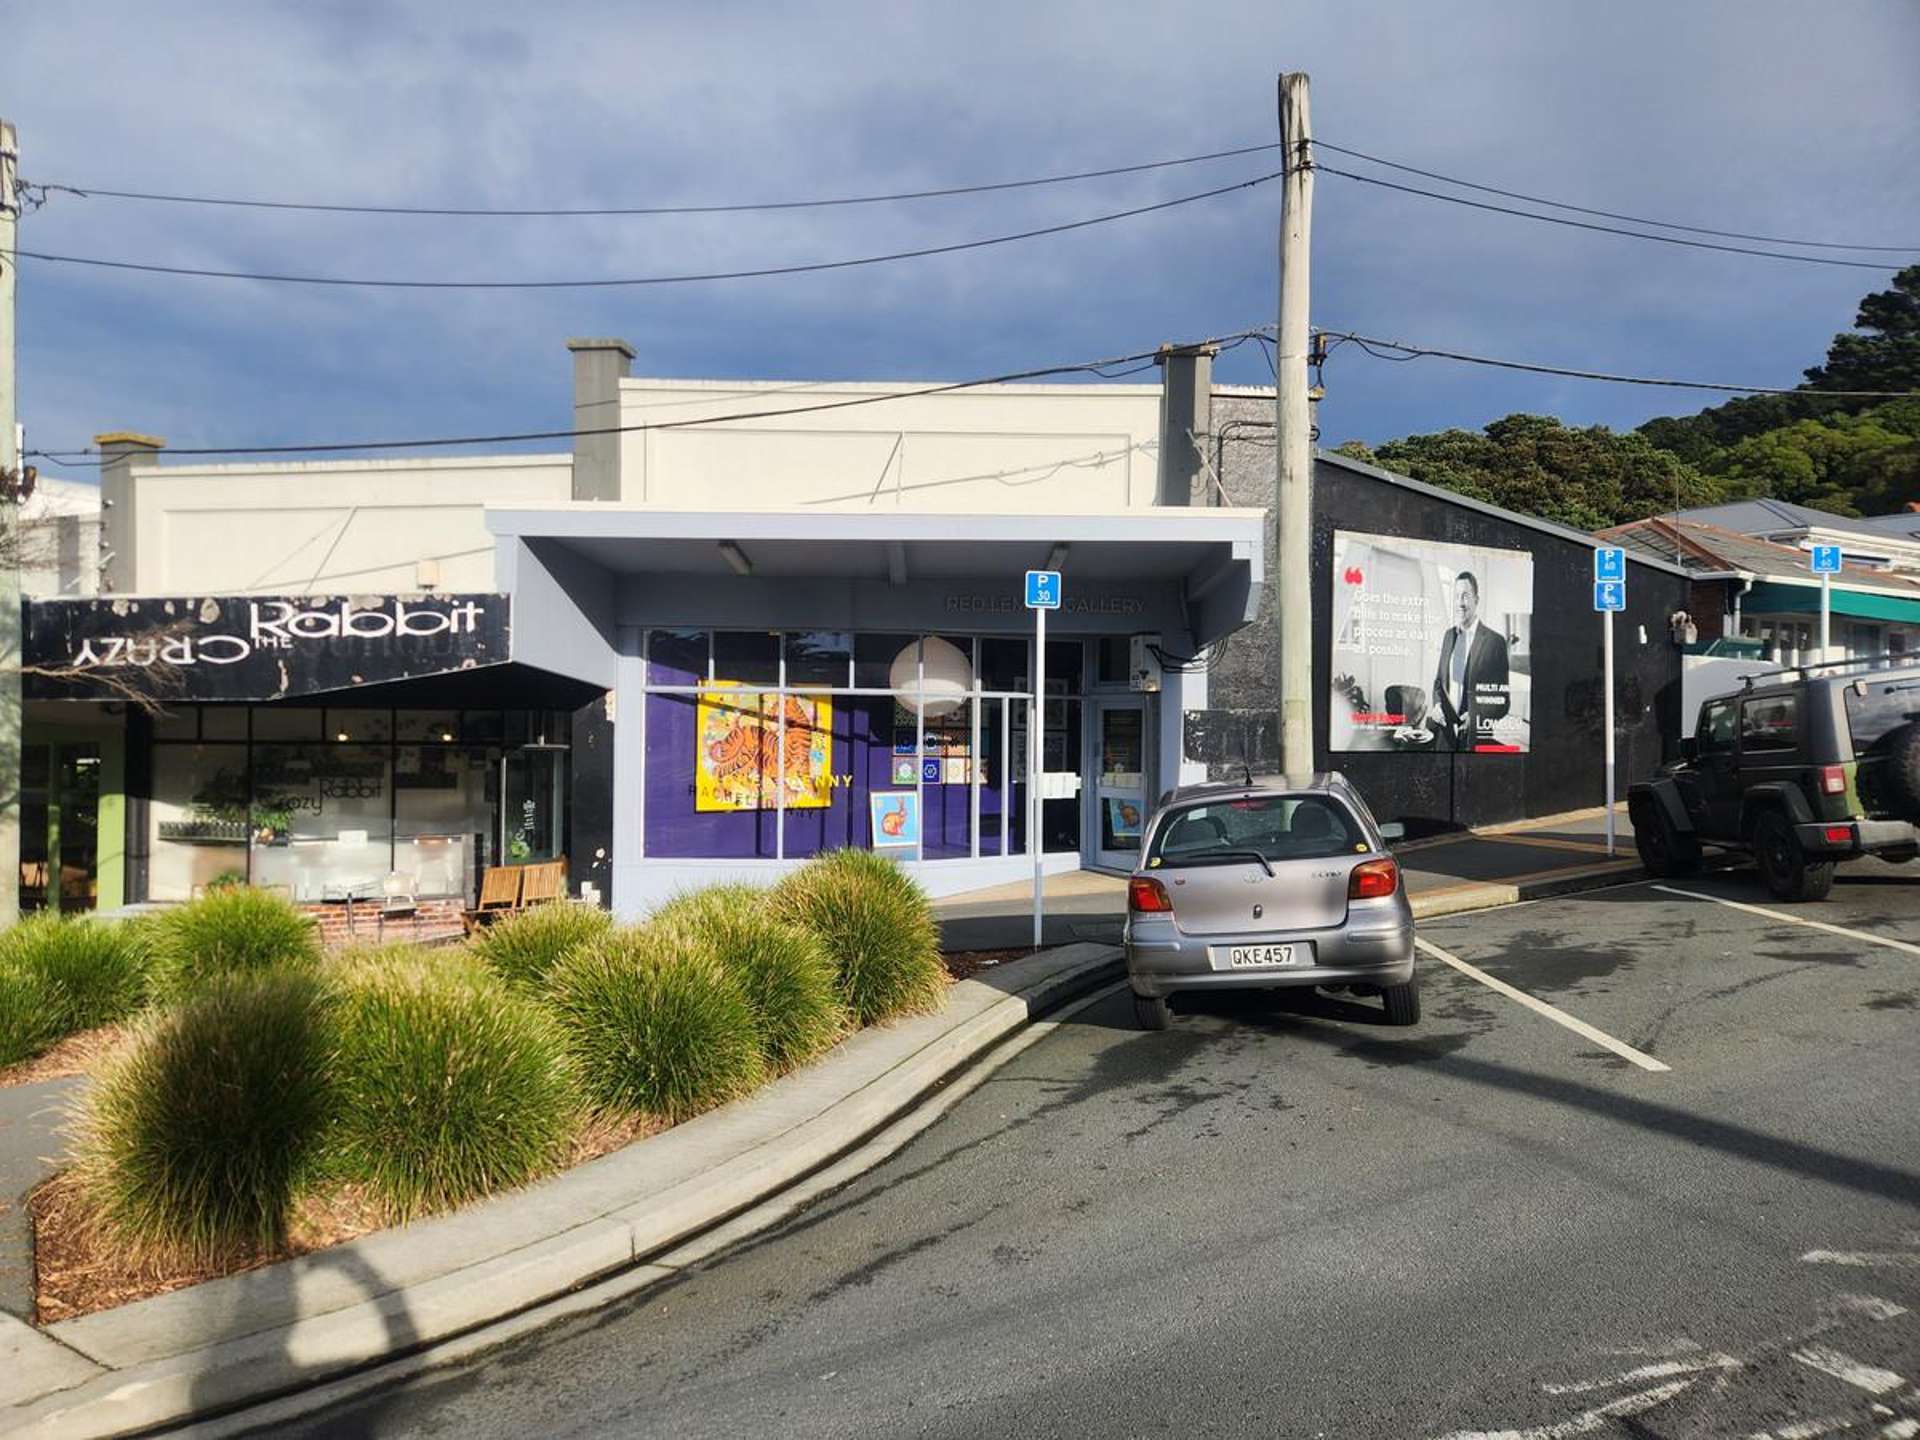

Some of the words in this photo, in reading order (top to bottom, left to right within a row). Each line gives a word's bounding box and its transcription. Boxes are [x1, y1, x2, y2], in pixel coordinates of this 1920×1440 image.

[1605, 551, 1615, 562] P
[1822, 548, 1831, 558] P
[1038, 575, 1049, 588] P
[1037, 590, 1050, 601] 30
[990, 595, 1026, 613] LEM
[250, 600, 485, 638] Rabbit
[73, 634, 250, 667] CRAZY
[253, 635, 293, 649] THE
[1232, 947, 1293, 965] QKE457
